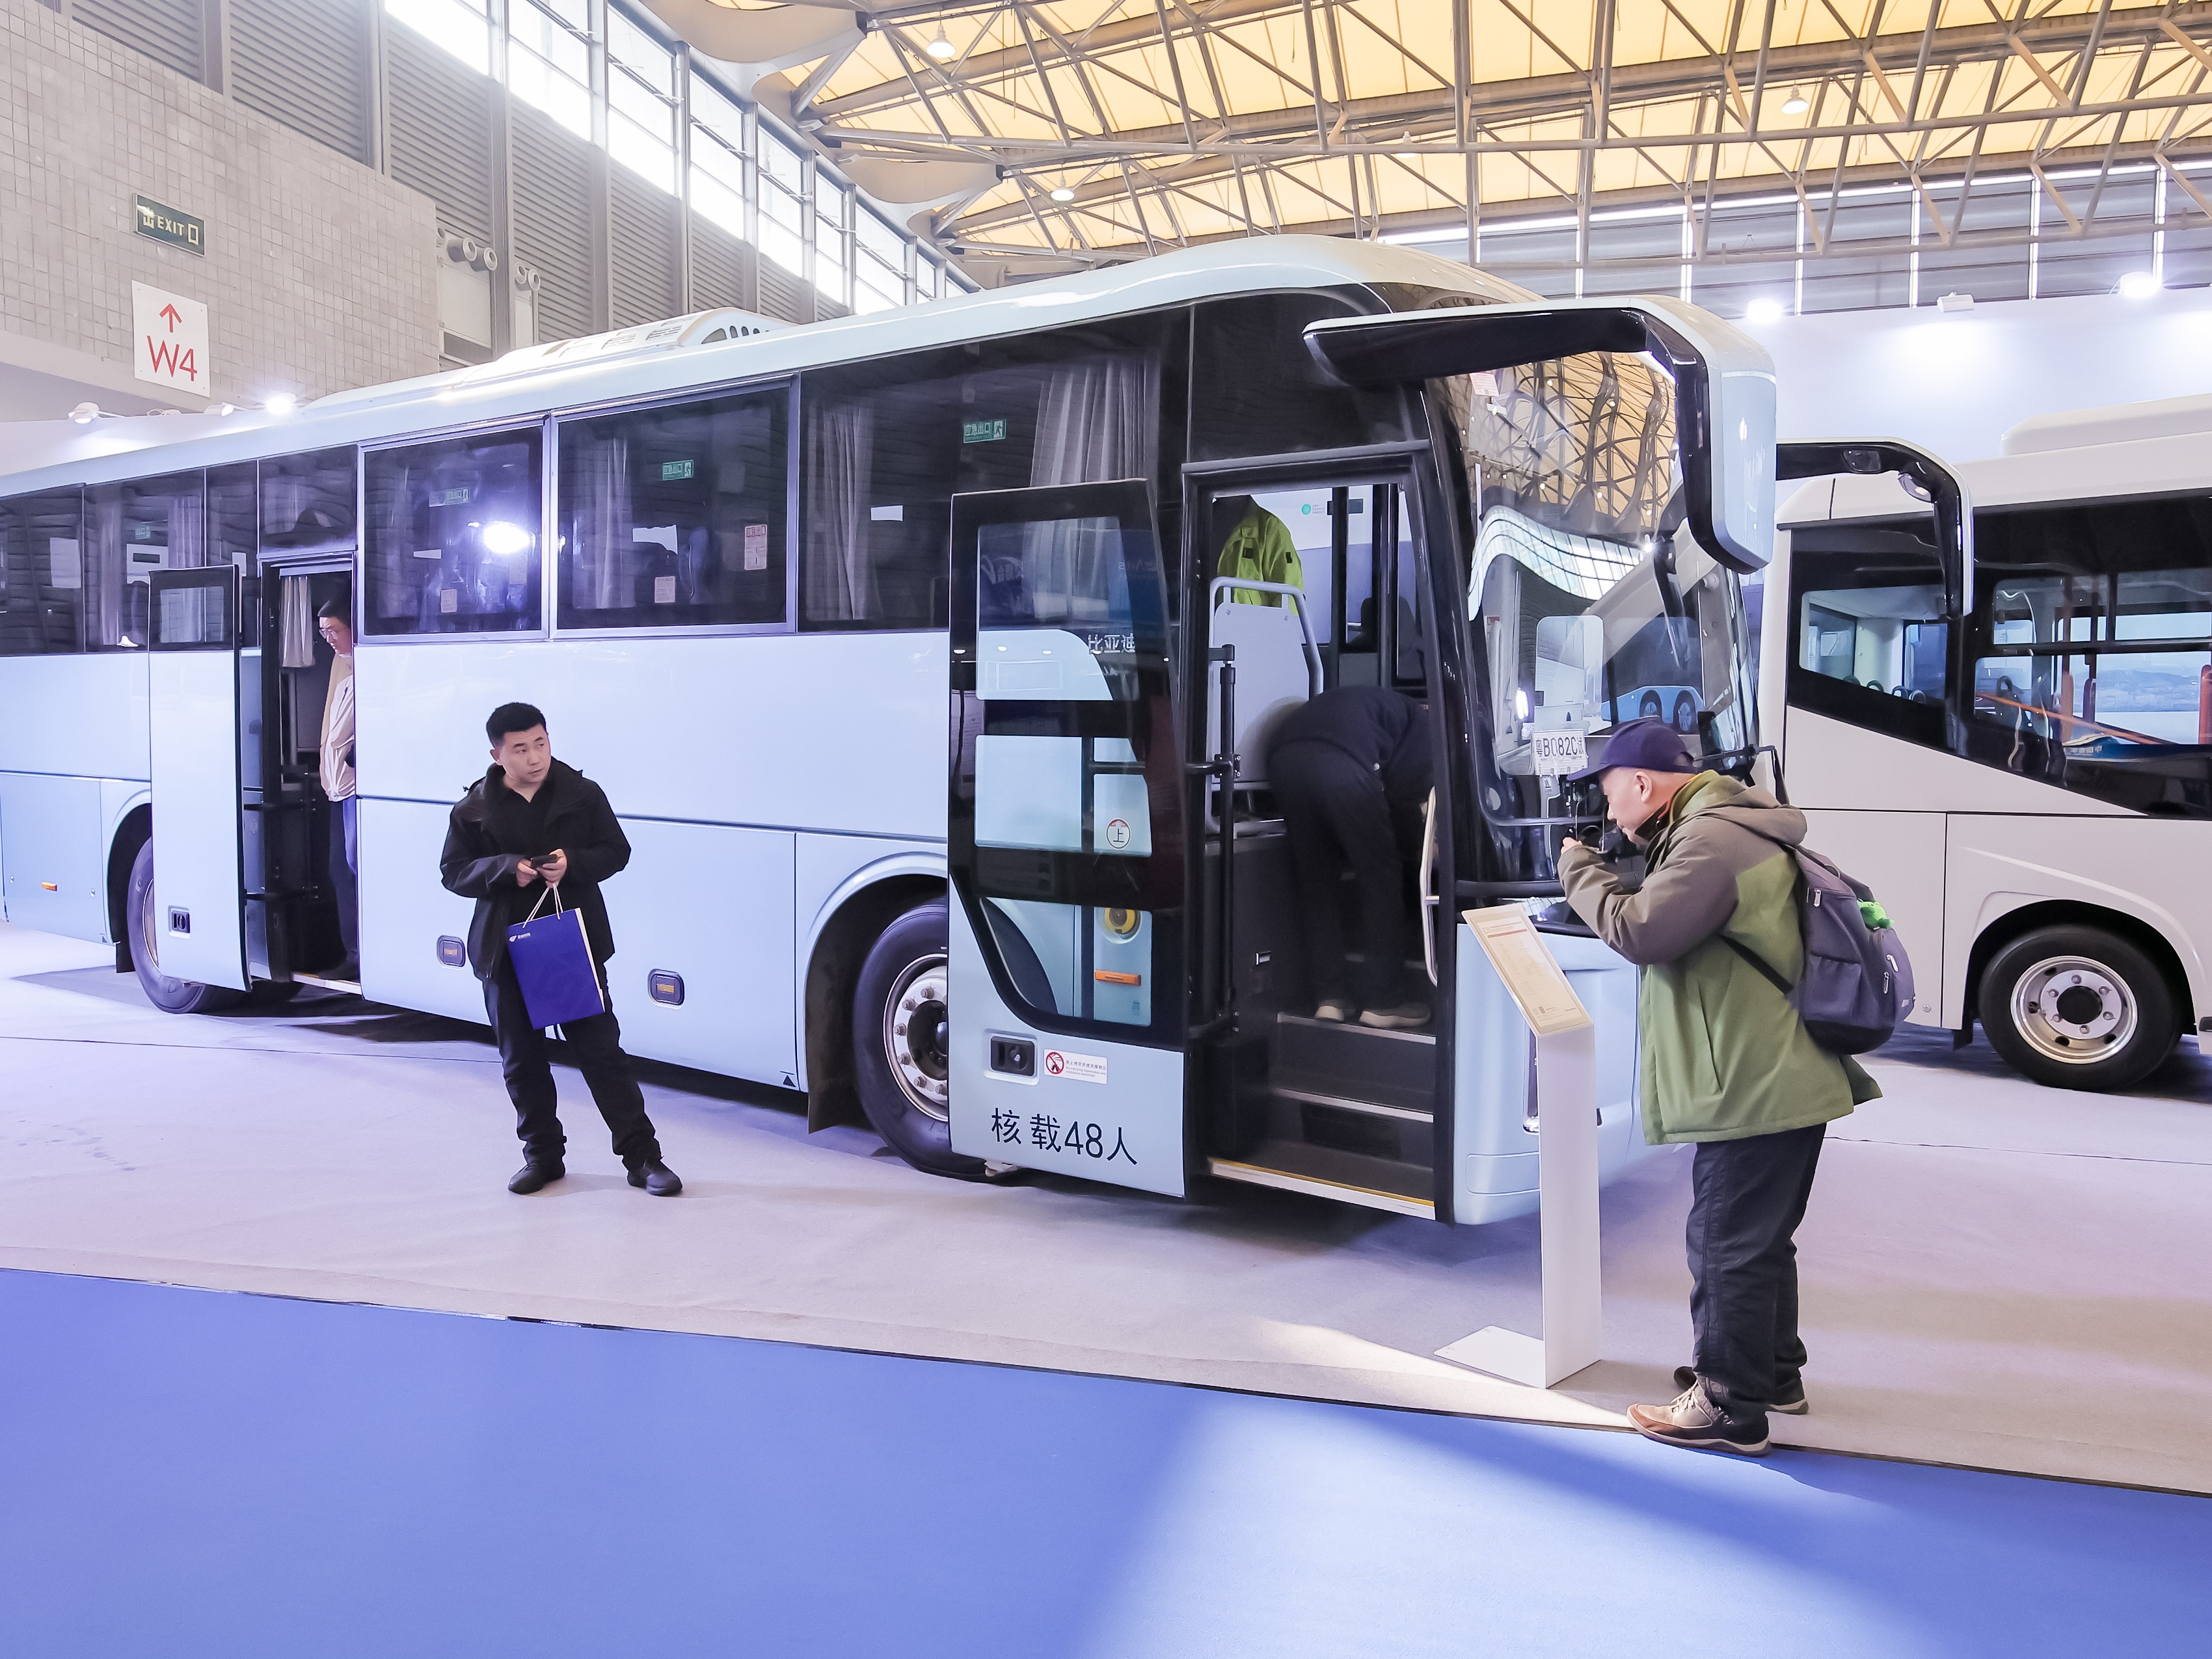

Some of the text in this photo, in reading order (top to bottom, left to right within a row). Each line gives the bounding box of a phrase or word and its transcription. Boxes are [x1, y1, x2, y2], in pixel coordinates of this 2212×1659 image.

[157, 215, 185, 237] EXIT
[187, 223, 199, 246] 口
[146, 334, 198, 383] W4
[1088, 632, 1136, 654] 比亚迪
[1113, 828, 1125, 843] 上
